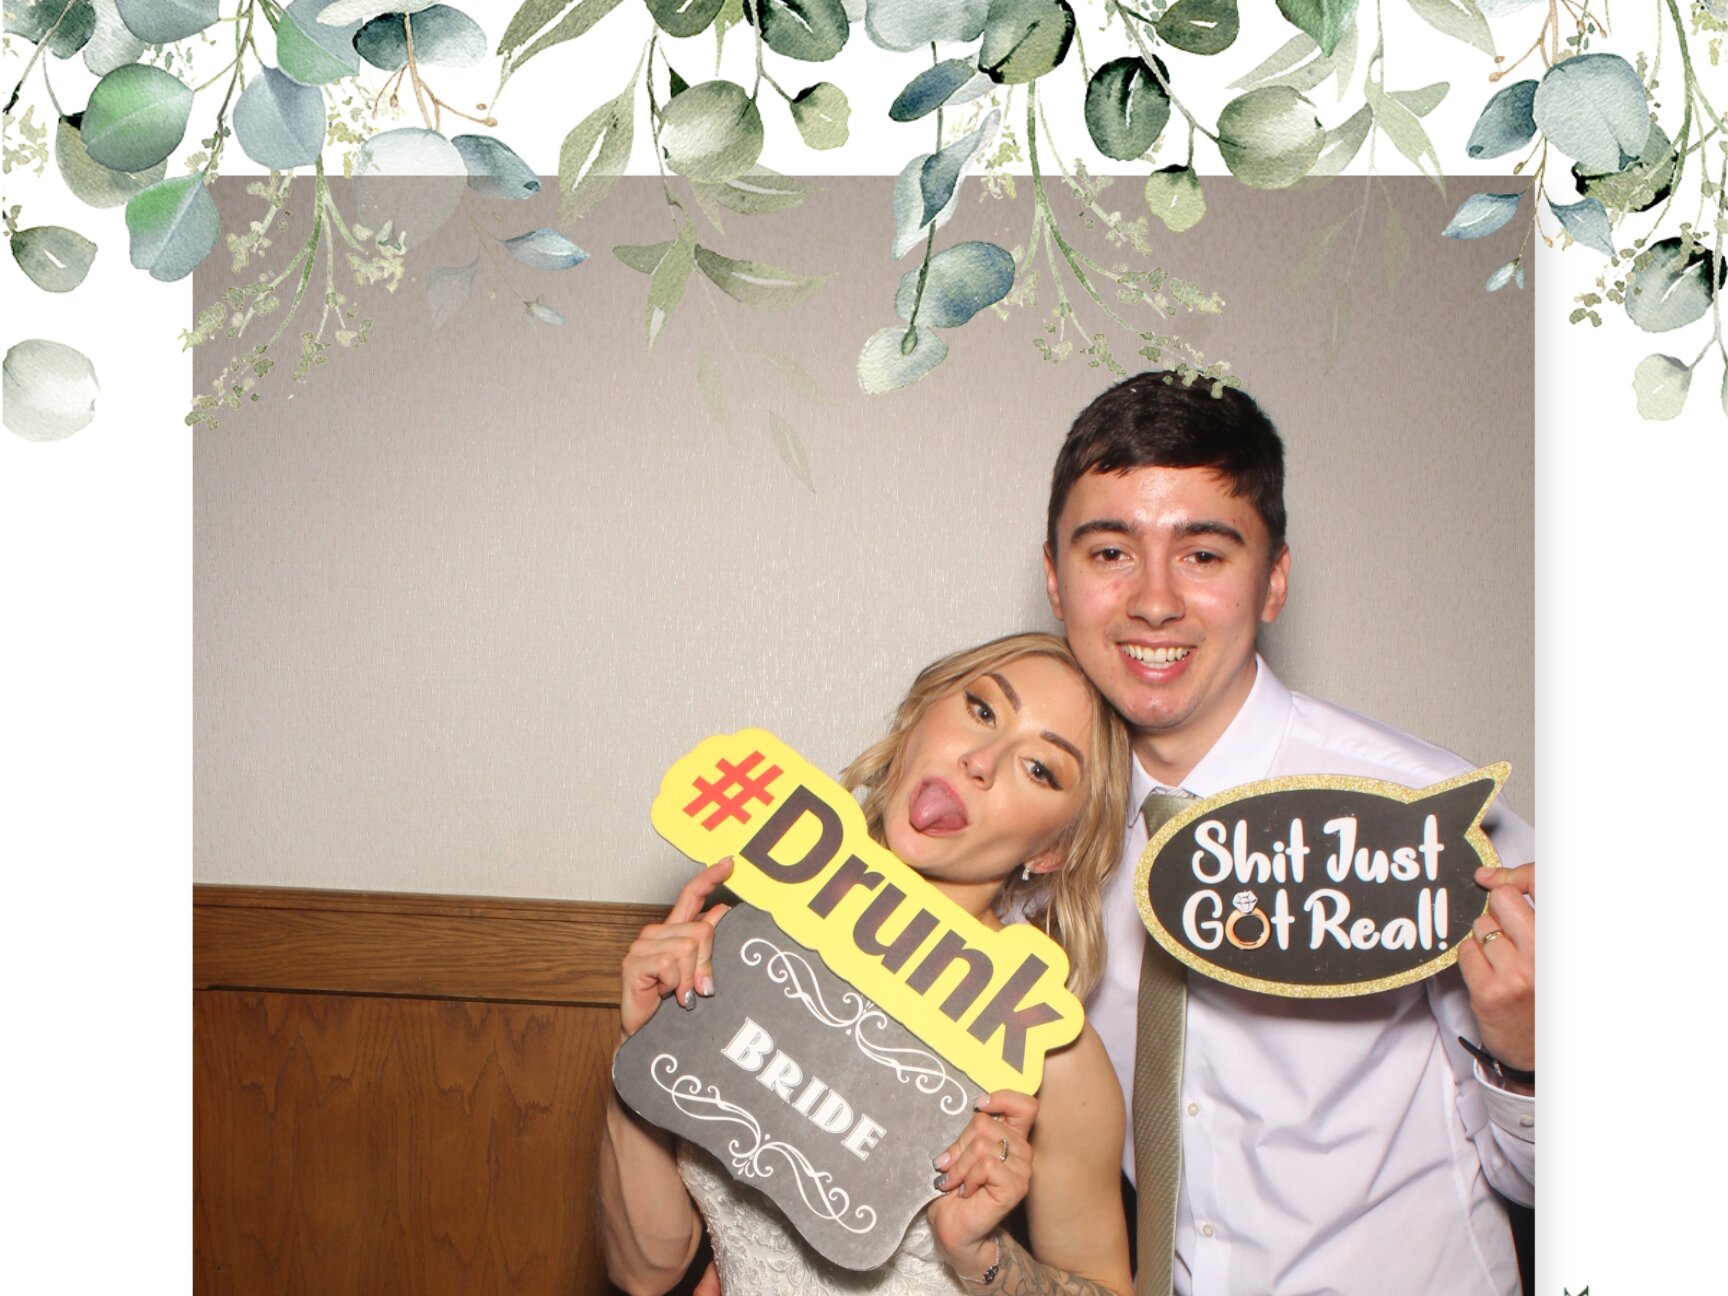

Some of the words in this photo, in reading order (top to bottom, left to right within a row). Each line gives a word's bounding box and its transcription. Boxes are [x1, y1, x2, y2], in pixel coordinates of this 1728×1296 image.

[1191, 817, 1311, 884] Shit
[1322, 813, 1445, 884] Just
[682, 749, 1065, 1076] #Drunk
[1181, 887, 1295, 951] Got
[1303, 887, 1449, 951] Real!
[719, 1016, 888, 1161] BRIDE
